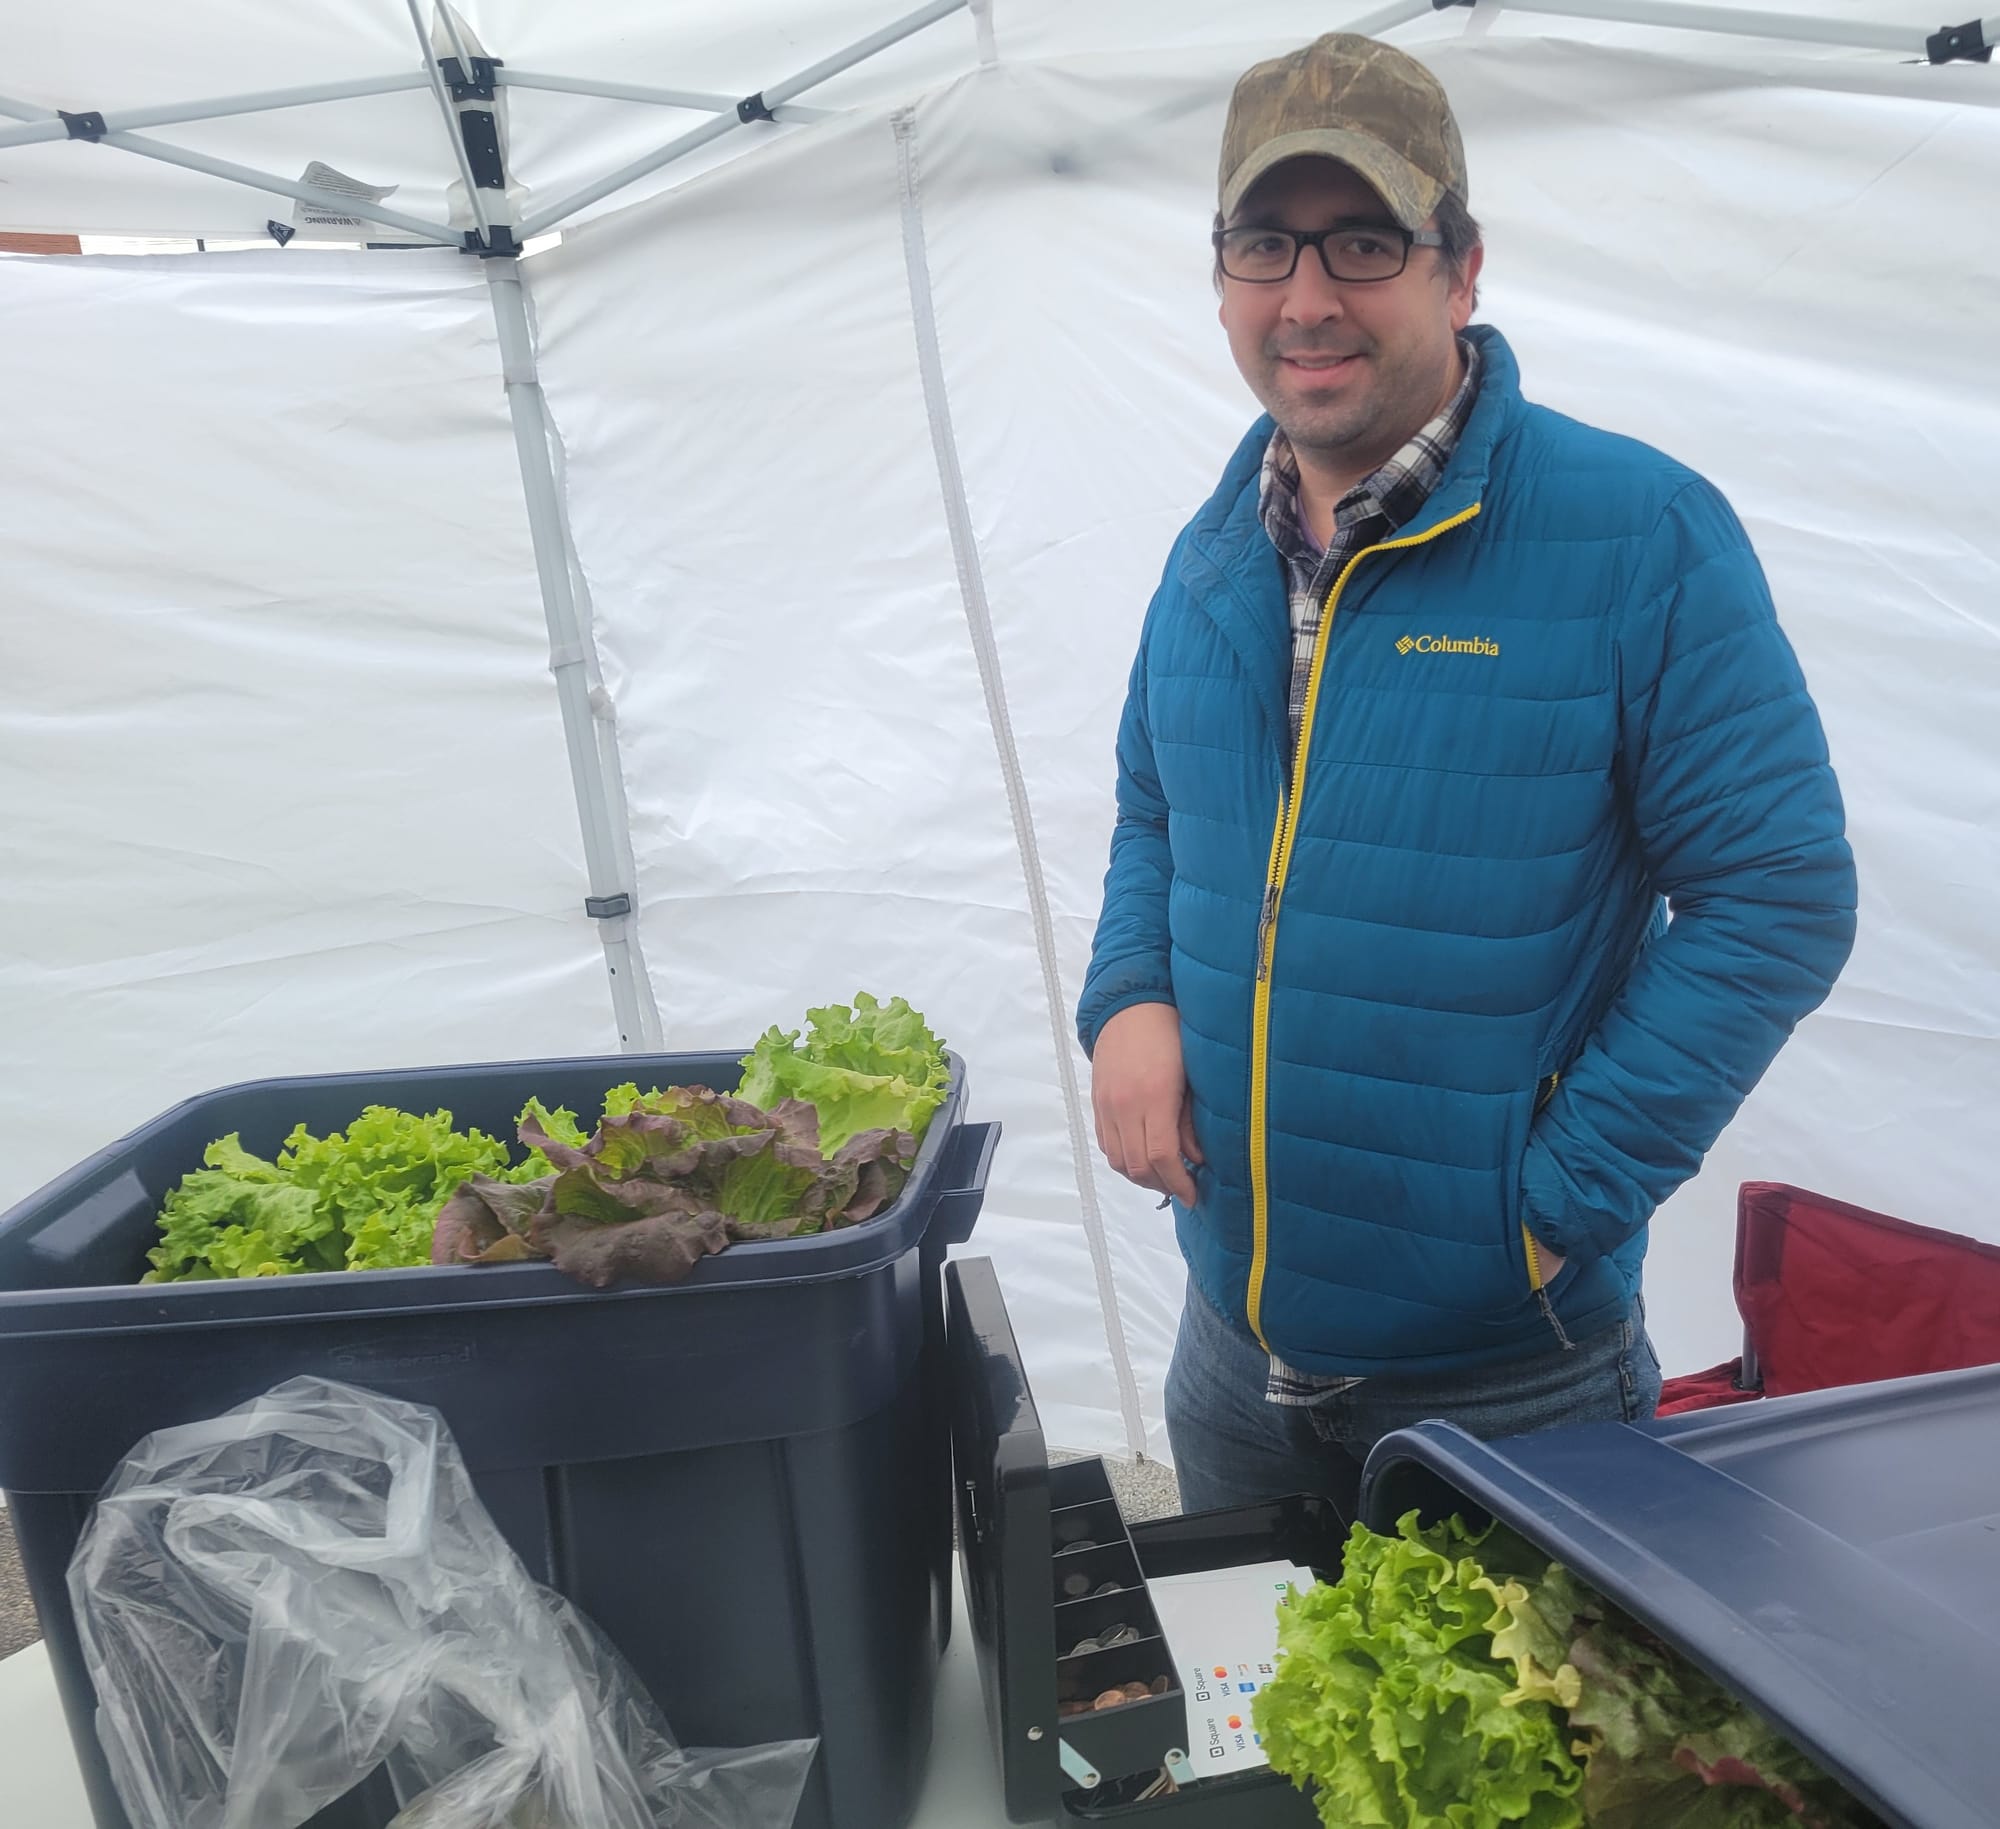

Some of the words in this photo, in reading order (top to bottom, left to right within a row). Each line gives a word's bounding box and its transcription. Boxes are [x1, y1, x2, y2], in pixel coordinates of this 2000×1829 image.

[304, 216, 354, 226] WARNING
[1415, 635, 1499, 656] Columbia
[1193, 1667, 1206, 1691] Square
[1219, 1682, 1231, 1697] VISA
[1207, 1718, 1220, 1746] Square
[1234, 1733, 1246, 1751] VISA
